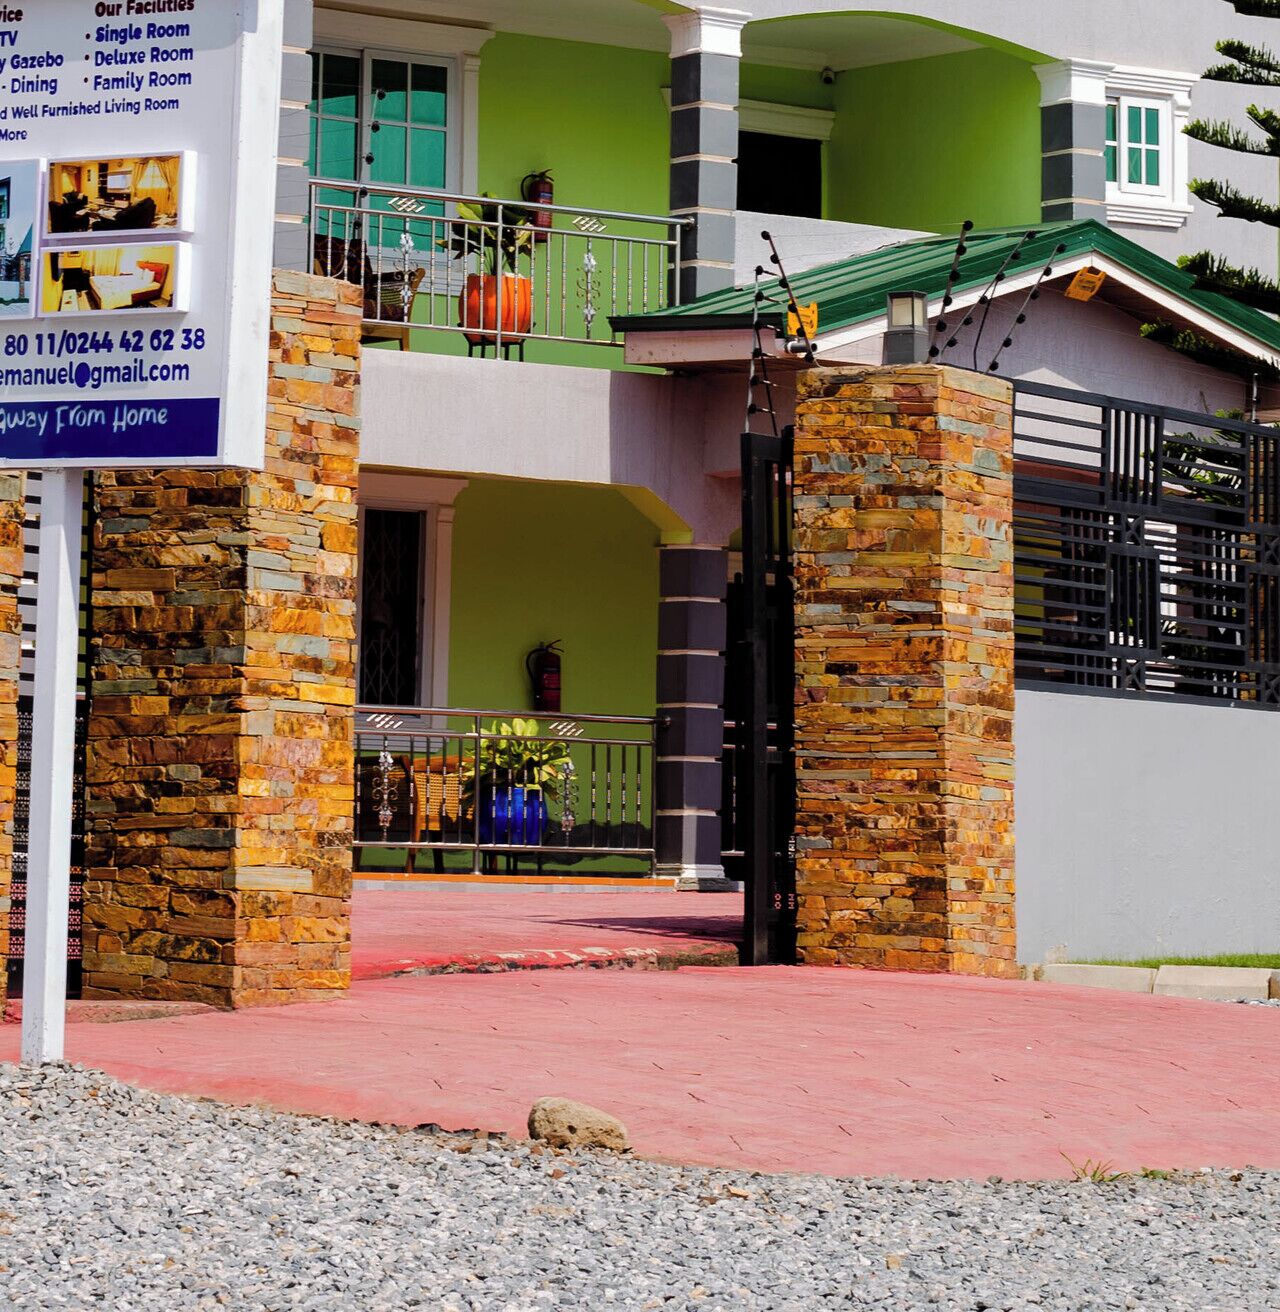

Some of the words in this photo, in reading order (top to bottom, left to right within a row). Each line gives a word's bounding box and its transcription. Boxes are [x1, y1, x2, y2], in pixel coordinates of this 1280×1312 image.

[95, 1, 122, 17] Our
[95, 23, 142, 45] Single
[146, 23, 190, 39] Room
[10, 51, 64, 70] Gazebo
[94, 49, 146, 67] Deluxe
[150, 47, 194, 63] Room
[11, 74, 58, 95] Dining
[94, 71, 144, 92] Family
[149, 71, 192, 87] Room
[11, 104, 38, 119] Well
[42, 101, 101, 117] Furnished
[105, 98, 140, 115] Living
[144, 98, 179, 111] Room
[4, 334, 28, 355] 80
[35, 329, 113, 357] 11/0244
[119, 330, 144, 352] 42
[150, 329, 174, 351] 62
[180, 328, 205, 350] 38
[55, 404, 106, 434] From
[112, 404, 169, 433] Home
